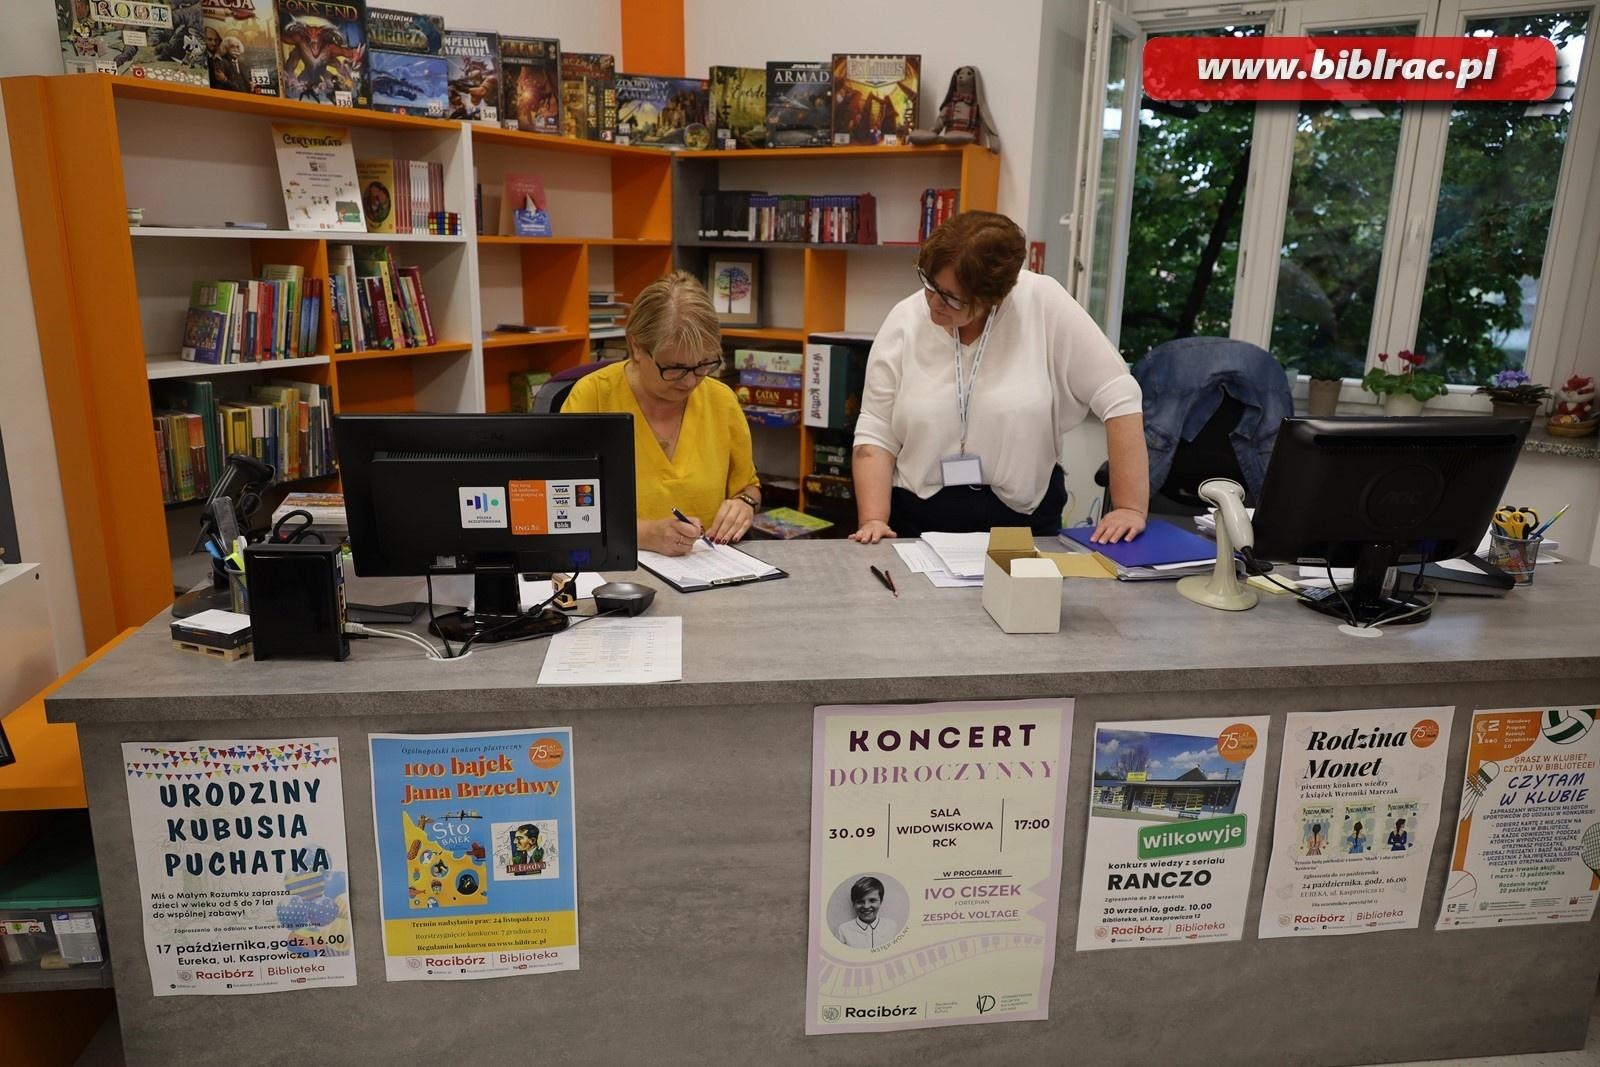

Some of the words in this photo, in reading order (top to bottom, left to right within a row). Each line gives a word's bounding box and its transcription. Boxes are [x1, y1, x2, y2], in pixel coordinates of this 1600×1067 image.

[95, 0, 168, 22] ROOT
[325, 5, 358, 21] END
[370, 11, 413, 22] NEUROSHIMA
[444, 37, 490, 51] MPERIUM
[251, 75, 269, 84] 332
[774, 71, 830, 82] ARMAD
[755, 390, 780, 401] CATAN
[849, 723, 1036, 752] KONCERT
[1306, 727, 1408, 751] Rodzina
[1412, 725, 1426, 740] 75
[1219, 731, 1240, 751] 75
[529, 745, 548, 761] 75
[1514, 755, 1541, 764] GRASZ
[1543, 754, 1551, 763] W
[1553, 753, 1587, 762] KLUBIE?
[404, 762, 446, 778] 100
[451, 754, 514, 778] bajek
[1302, 757, 1383, 780] Monet
[1503, 763, 1533, 773] CZYTAJ
[1535, 763, 1543, 771] W
[1545, 761, 1596, 771] BIBLIOTECE!
[829, 760, 1057, 787] DOBROCZYNNY
[1364, 780, 1388, 788] wiedzy
[1508, 773, 1586, 789] CZYTAM
[159, 778, 321, 808] URODZINY
[401, 783, 452, 805] Jana
[456, 777, 560, 798] Brzechwy
[1335, 789, 1367, 797] Weroniki
[1369, 787, 1399, 795] Marczak
[1500, 791, 1517, 806] W
[1524, 788, 1589, 805] KLUBIE
[929, 807, 961, 818] SALA
[167, 814, 308, 842] KUBUSIA
[432, 822, 471, 840] Sto
[896, 820, 994, 835] WIDOWISKOWA
[1014, 818, 1051, 830] 17:00
[828, 827, 876, 840] 30.09
[1143, 824, 1242, 850] Wilkowyje
[441, 835, 471, 847] BAJEK
[932, 837, 957, 848] RCK
[165, 848, 330, 877] PUCHATKA
[1108, 861, 1148, 870] konkurs
[1150, 859, 1184, 869] wiedzy
[1192, 857, 1225, 866] serialu
[953, 868, 1003, 877] PROGRAMIE
[1107, 869, 1212, 891] RANCZO
[1364, 877, 1384, 887] godz.
[151, 891, 165, 900] Miś
[176, 891, 208, 901] Małym
[209, 890, 249, 899] Rozumku
[252, 889, 291, 898] zaprasza
[924, 886, 956, 901] IVO
[960, 883, 1022, 898] CISZEK
[151, 901, 179, 909] dzieci
[190, 900, 217, 909] wieku
[219, 899, 231, 907] od
[240, 899, 253, 907] do
[1103, 907, 1115, 915] 30
[1117, 905, 1161, 914] września,
[1162, 904, 1187, 915] godz.
[1189, 902, 1212, 911] 10.00
[152, 911, 165, 919] do
[167, 910, 206, 920] wspólnej
[208, 909, 246, 918] zabawy!
[922, 910, 966, 922] ZESPÓŁ
[968, 909, 1020, 919] VOLTAGE
[1102, 916, 1139, 924] Biblioteka,
[1150, 914, 1194, 923] Kasprowicza
[1294, 913, 1345, 924] Racibórz
[1356, 909, 1404, 921] Biblioteka
[411, 920, 437, 928] Termin
[502, 916, 533, 924] listopada
[1110, 925, 1164, 936] Racibórz
[1175, 921, 1226, 933] Biblioteka
[156, 944, 172, 954] 17
[178, 956, 220, 966] Eureka,
[223, 955, 236, 964] ul.
[239, 951, 310, 963] Kasprowicza
[313, 949, 326, 957] 12
[425, 955, 486, 967] Racibórz
[499, 950, 558, 964] Biblioteka
[195, 968, 254, 980] Racibórz
[267, 964, 325, 976] Biblioteka
[844, 1005, 918, 1019] Racibórz
